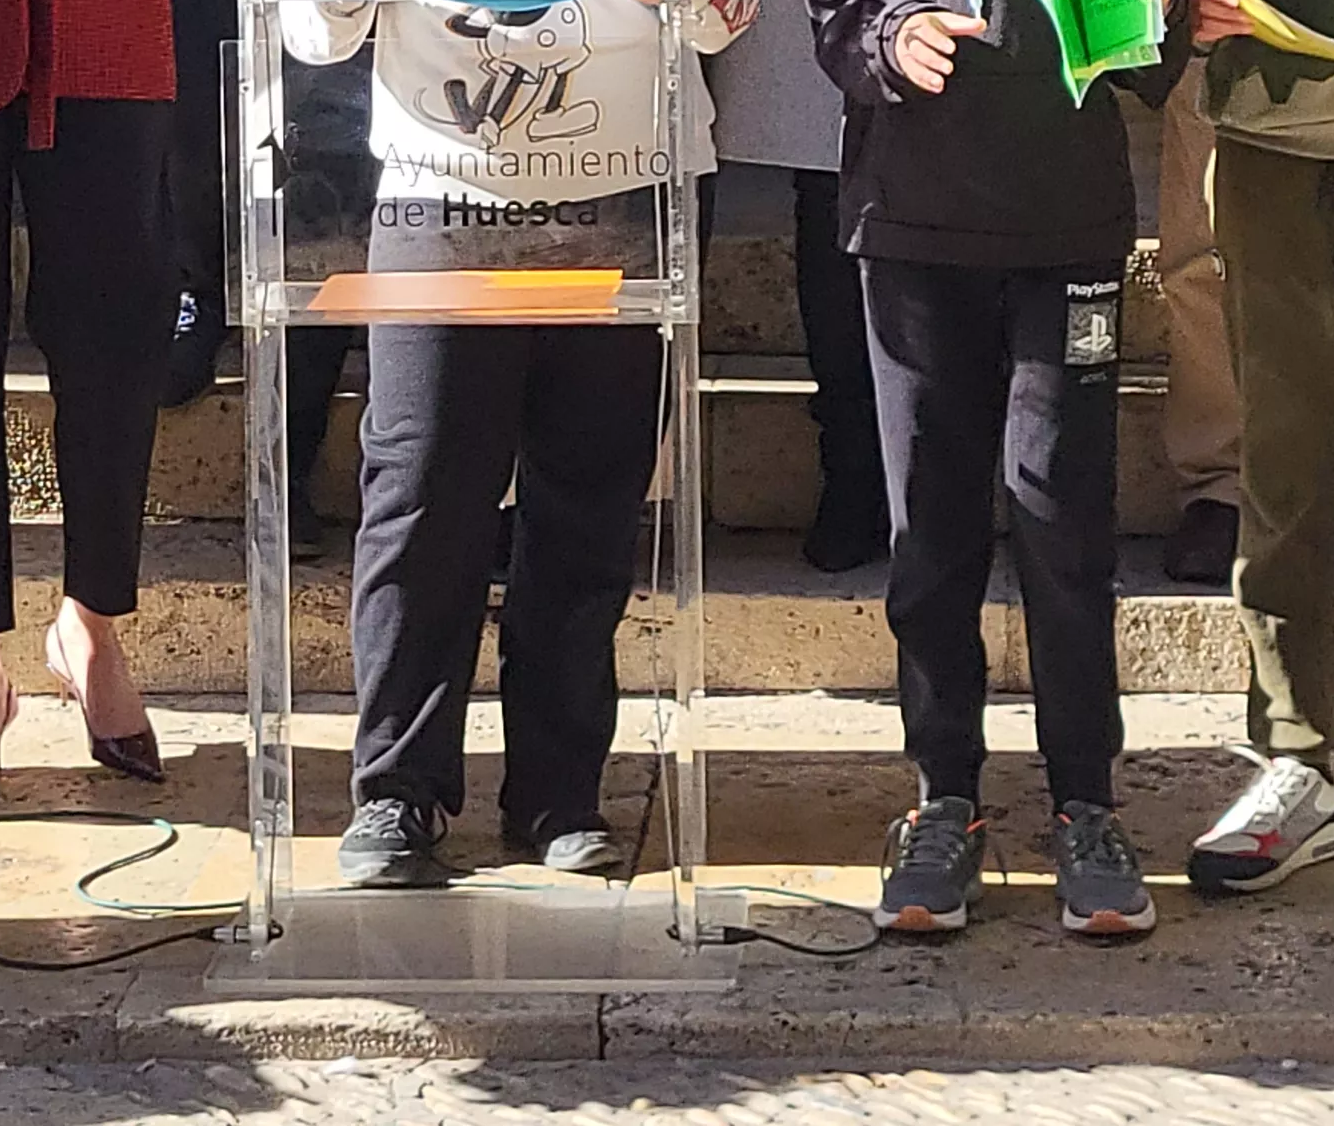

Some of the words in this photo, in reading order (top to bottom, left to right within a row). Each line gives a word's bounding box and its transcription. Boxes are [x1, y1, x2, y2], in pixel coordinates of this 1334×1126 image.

[380, 141, 670, 187] Ayuntamiento
[377, 195, 425, 227] de
[442, 191, 599, 228] Huesca
